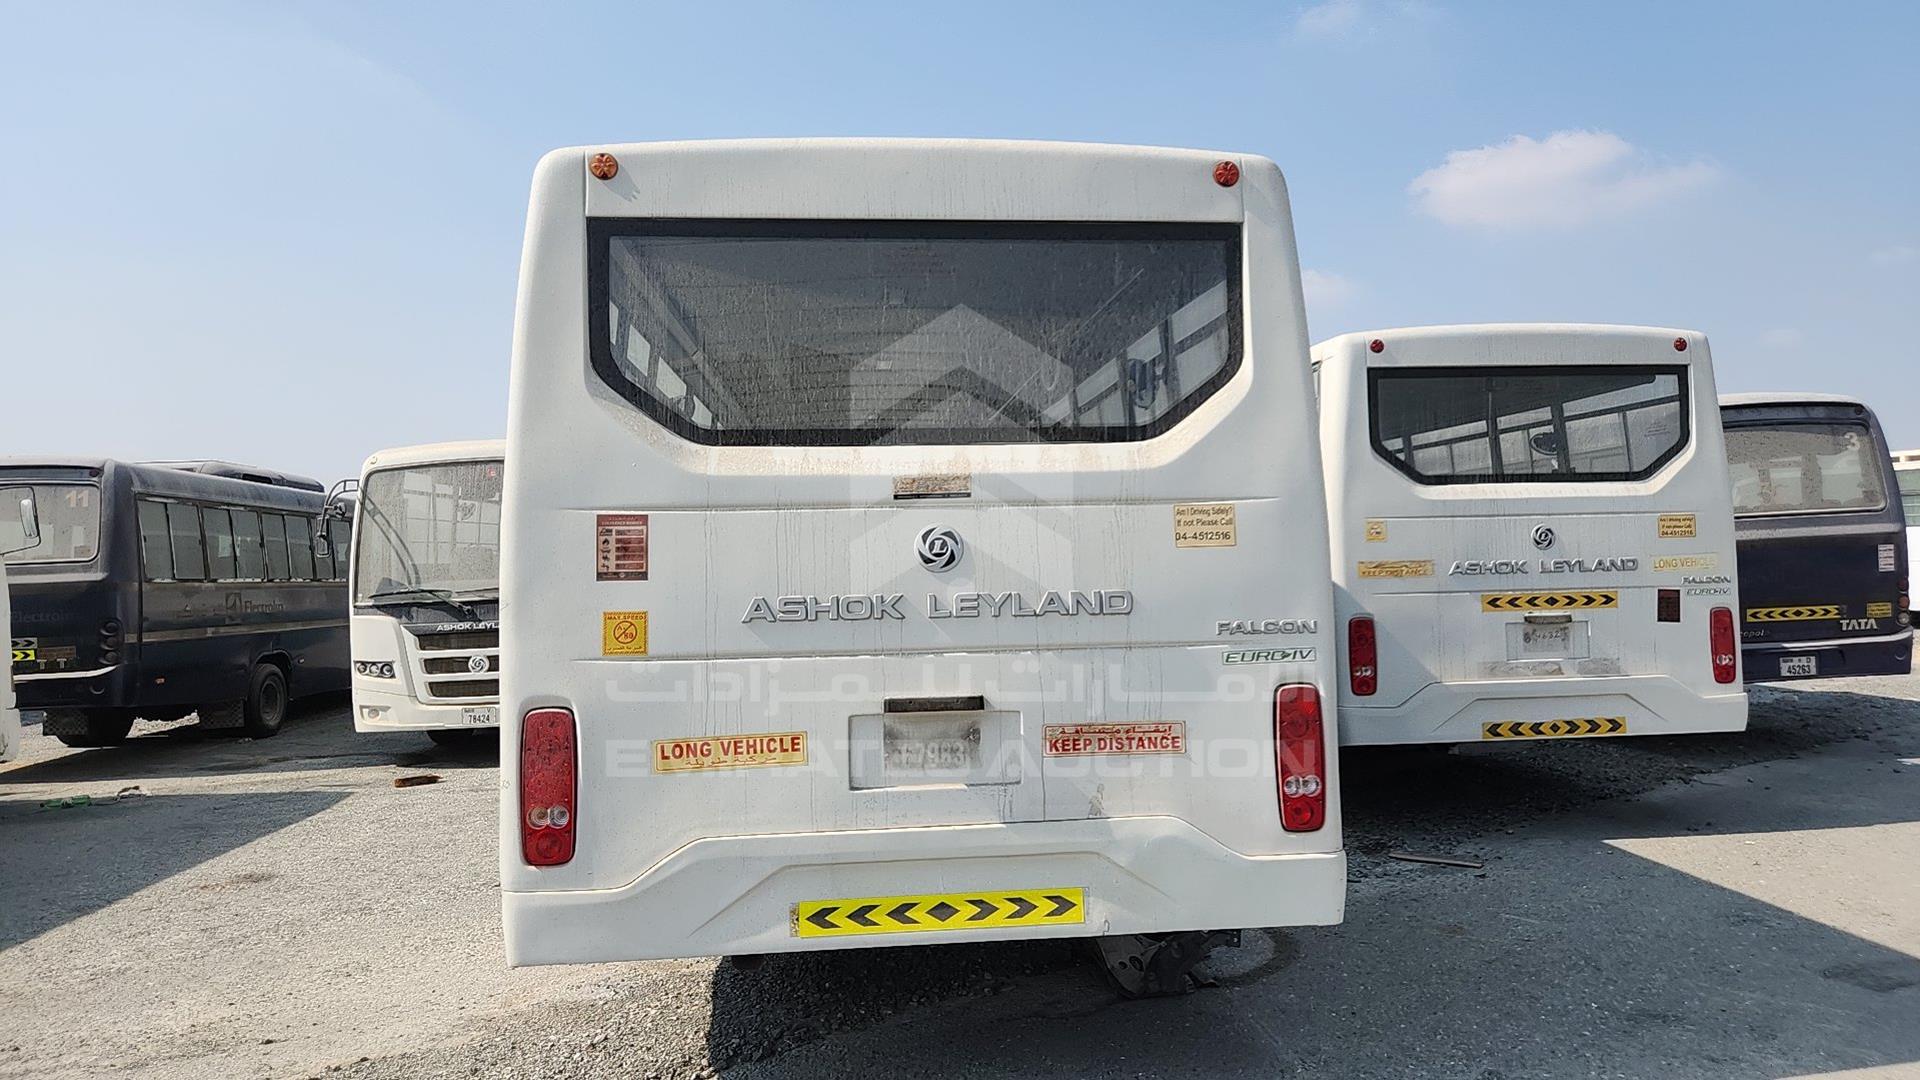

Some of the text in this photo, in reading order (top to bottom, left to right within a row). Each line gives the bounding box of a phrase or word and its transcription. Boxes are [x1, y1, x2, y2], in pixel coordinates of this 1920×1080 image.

[65, 490, 89, 507] 11
[1175, 531, 1231, 541] 04-4512516
[1449, 557, 1638, 576] ASHOK LEYLAND
[1654, 559, 1678, 568] LONG
[1681, 576, 1731, 584] FALCON
[741, 589, 1134, 624] ASHOK LEYLAND
[436, 622, 472, 632] ASHOK
[1216, 619, 1318, 635] FALCON
[1840, 618, 1878, 631] TATA
[1787, 664, 1811, 675] 45263
[468, 714, 490, 724] 78424
[660, 736, 801, 760] LONG VEHICLE
[1049, 735, 1181, 752] KEEP DISTANCE
